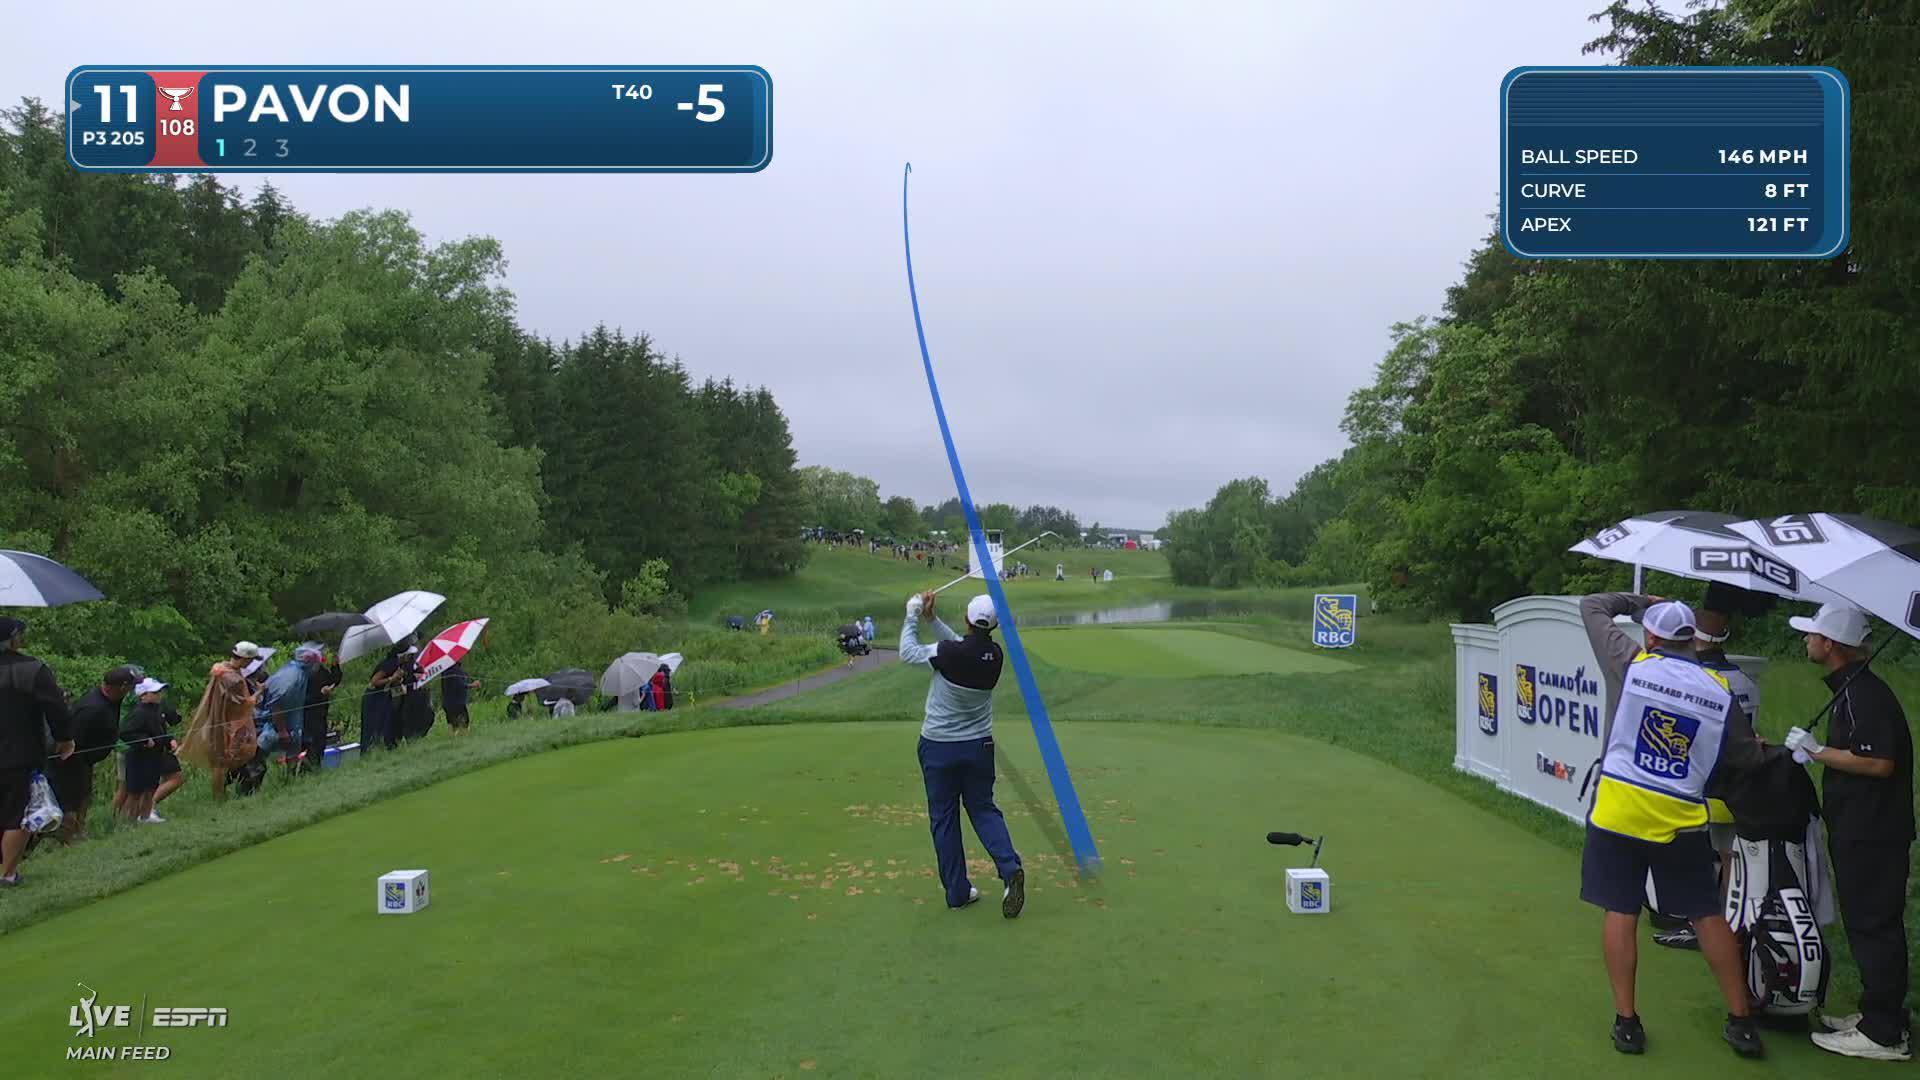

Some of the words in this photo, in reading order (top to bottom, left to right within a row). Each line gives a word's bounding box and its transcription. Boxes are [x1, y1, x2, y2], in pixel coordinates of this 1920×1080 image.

[1700, 551, 1792, 585] PING
[1480, 715, 1495, 732] RBC
[1538, 694, 1599, 739] OPEN
[1639, 752, 1685, 778] RBC
[1303, 900, 1321, 908] RBC
[1786, 896, 1822, 962] PING
